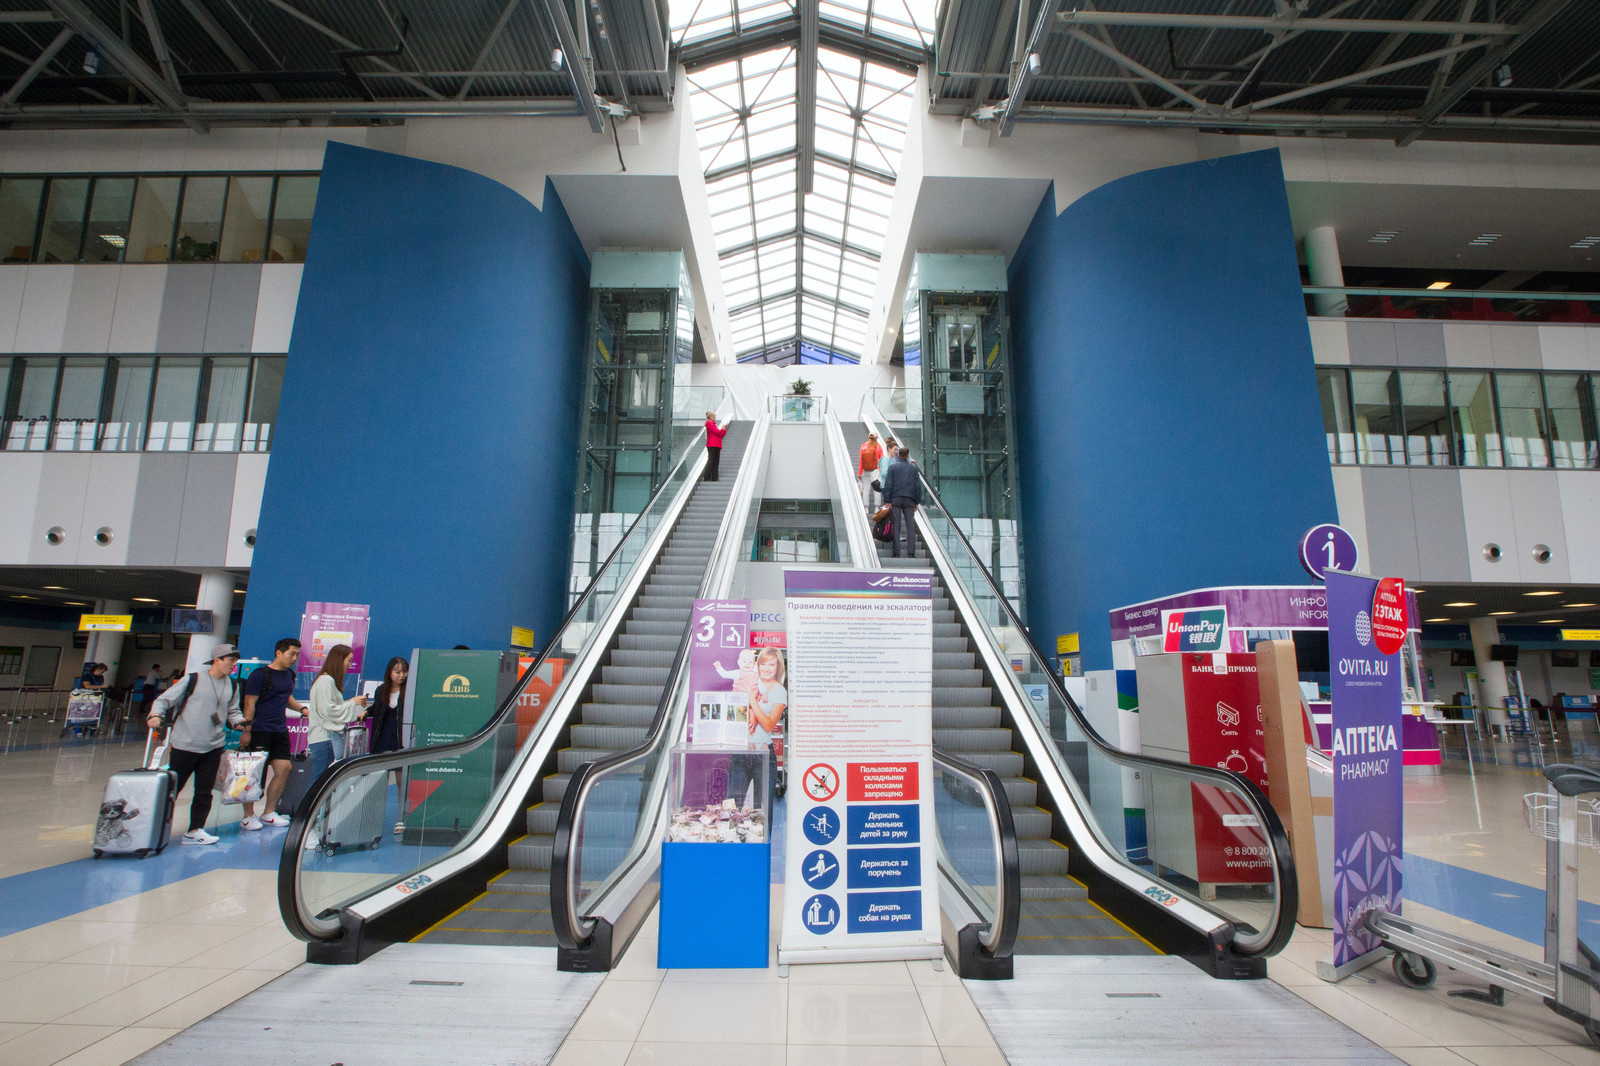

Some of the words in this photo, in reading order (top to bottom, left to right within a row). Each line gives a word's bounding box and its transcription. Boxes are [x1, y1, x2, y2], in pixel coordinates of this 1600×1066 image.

[1290, 596, 1327, 606] ИНФО
[1380, 592, 1398, 603] АПТЕКА
[787, 602, 824, 610] Правила
[886, 604, 932, 612] эскалаторе
[750, 613, 785, 622] РЕСС-
[1124, 609, 1142, 620] Бизнес
[1142, 608, 1158, 618] центр
[1375, 604, 1380, 616] 2
[1380, 604, 1403, 622] ЭТАЖ
[696, 615, 716, 642] 3
[1169, 620, 1221, 634] UnionPay
[1189, 632, 1217, 644] 银联
[1339, 658, 1388, 676] OVITA.RU
[1332, 724, 1398, 757] АПТЕКА
[1341, 758, 1390, 780] PHARMACY
[868, 812, 900, 820] Держать
[860, 830, 881, 838] детей
[892, 830, 908, 838] руку
[1234, 846, 1240, 856] 8
[1242, 846, 1258, 856] 800
[860, 860, 900, 868] Держаться
[868, 870, 902, 878] поручень
[868, 904, 901, 912] Держать
[858, 914, 880, 922] собак
[891, 914, 912, 922] руках
